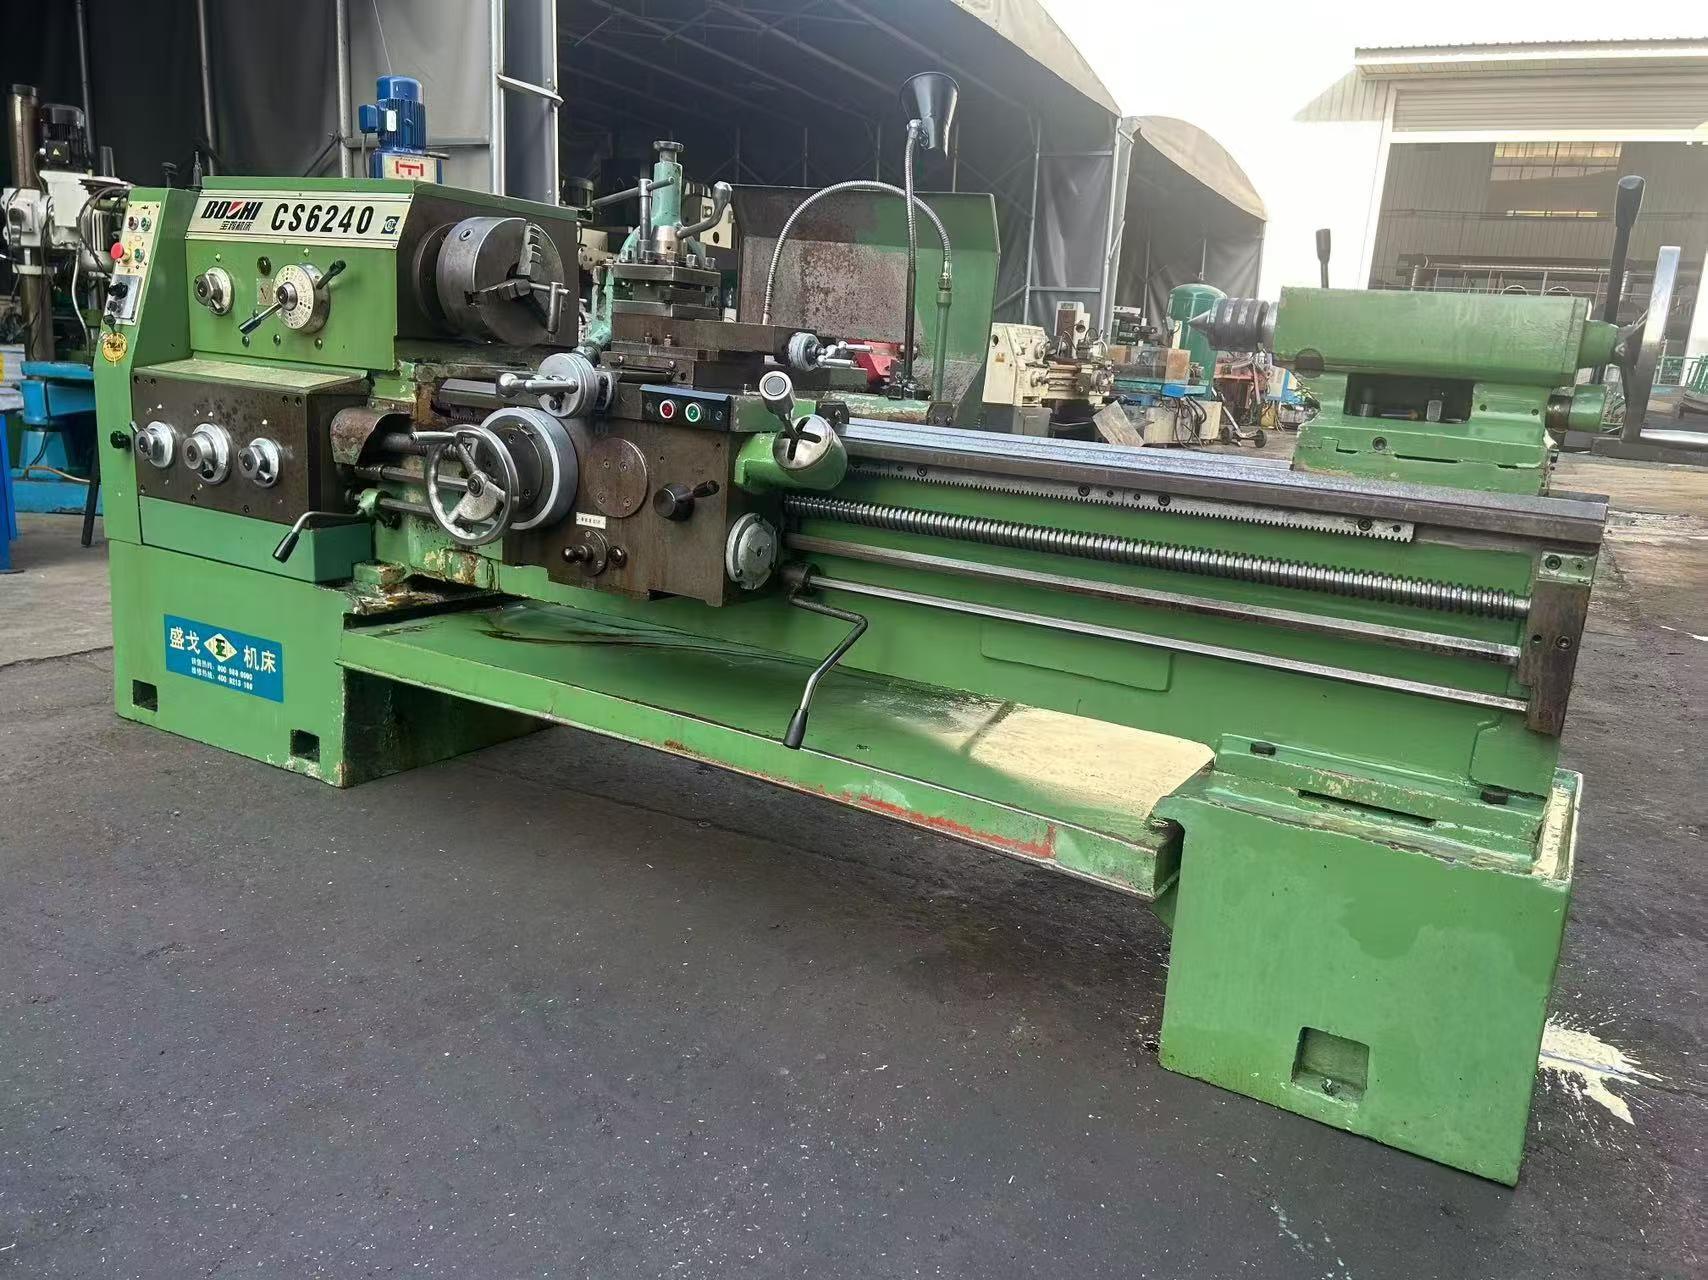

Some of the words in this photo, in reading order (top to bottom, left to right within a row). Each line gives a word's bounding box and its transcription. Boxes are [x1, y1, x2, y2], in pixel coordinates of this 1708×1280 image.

[270, 203, 374, 234] CS6240
[170, 626, 200, 655] 盛戈
[243, 644, 277, 674] 机床
[217, 674, 227, 683] 400
